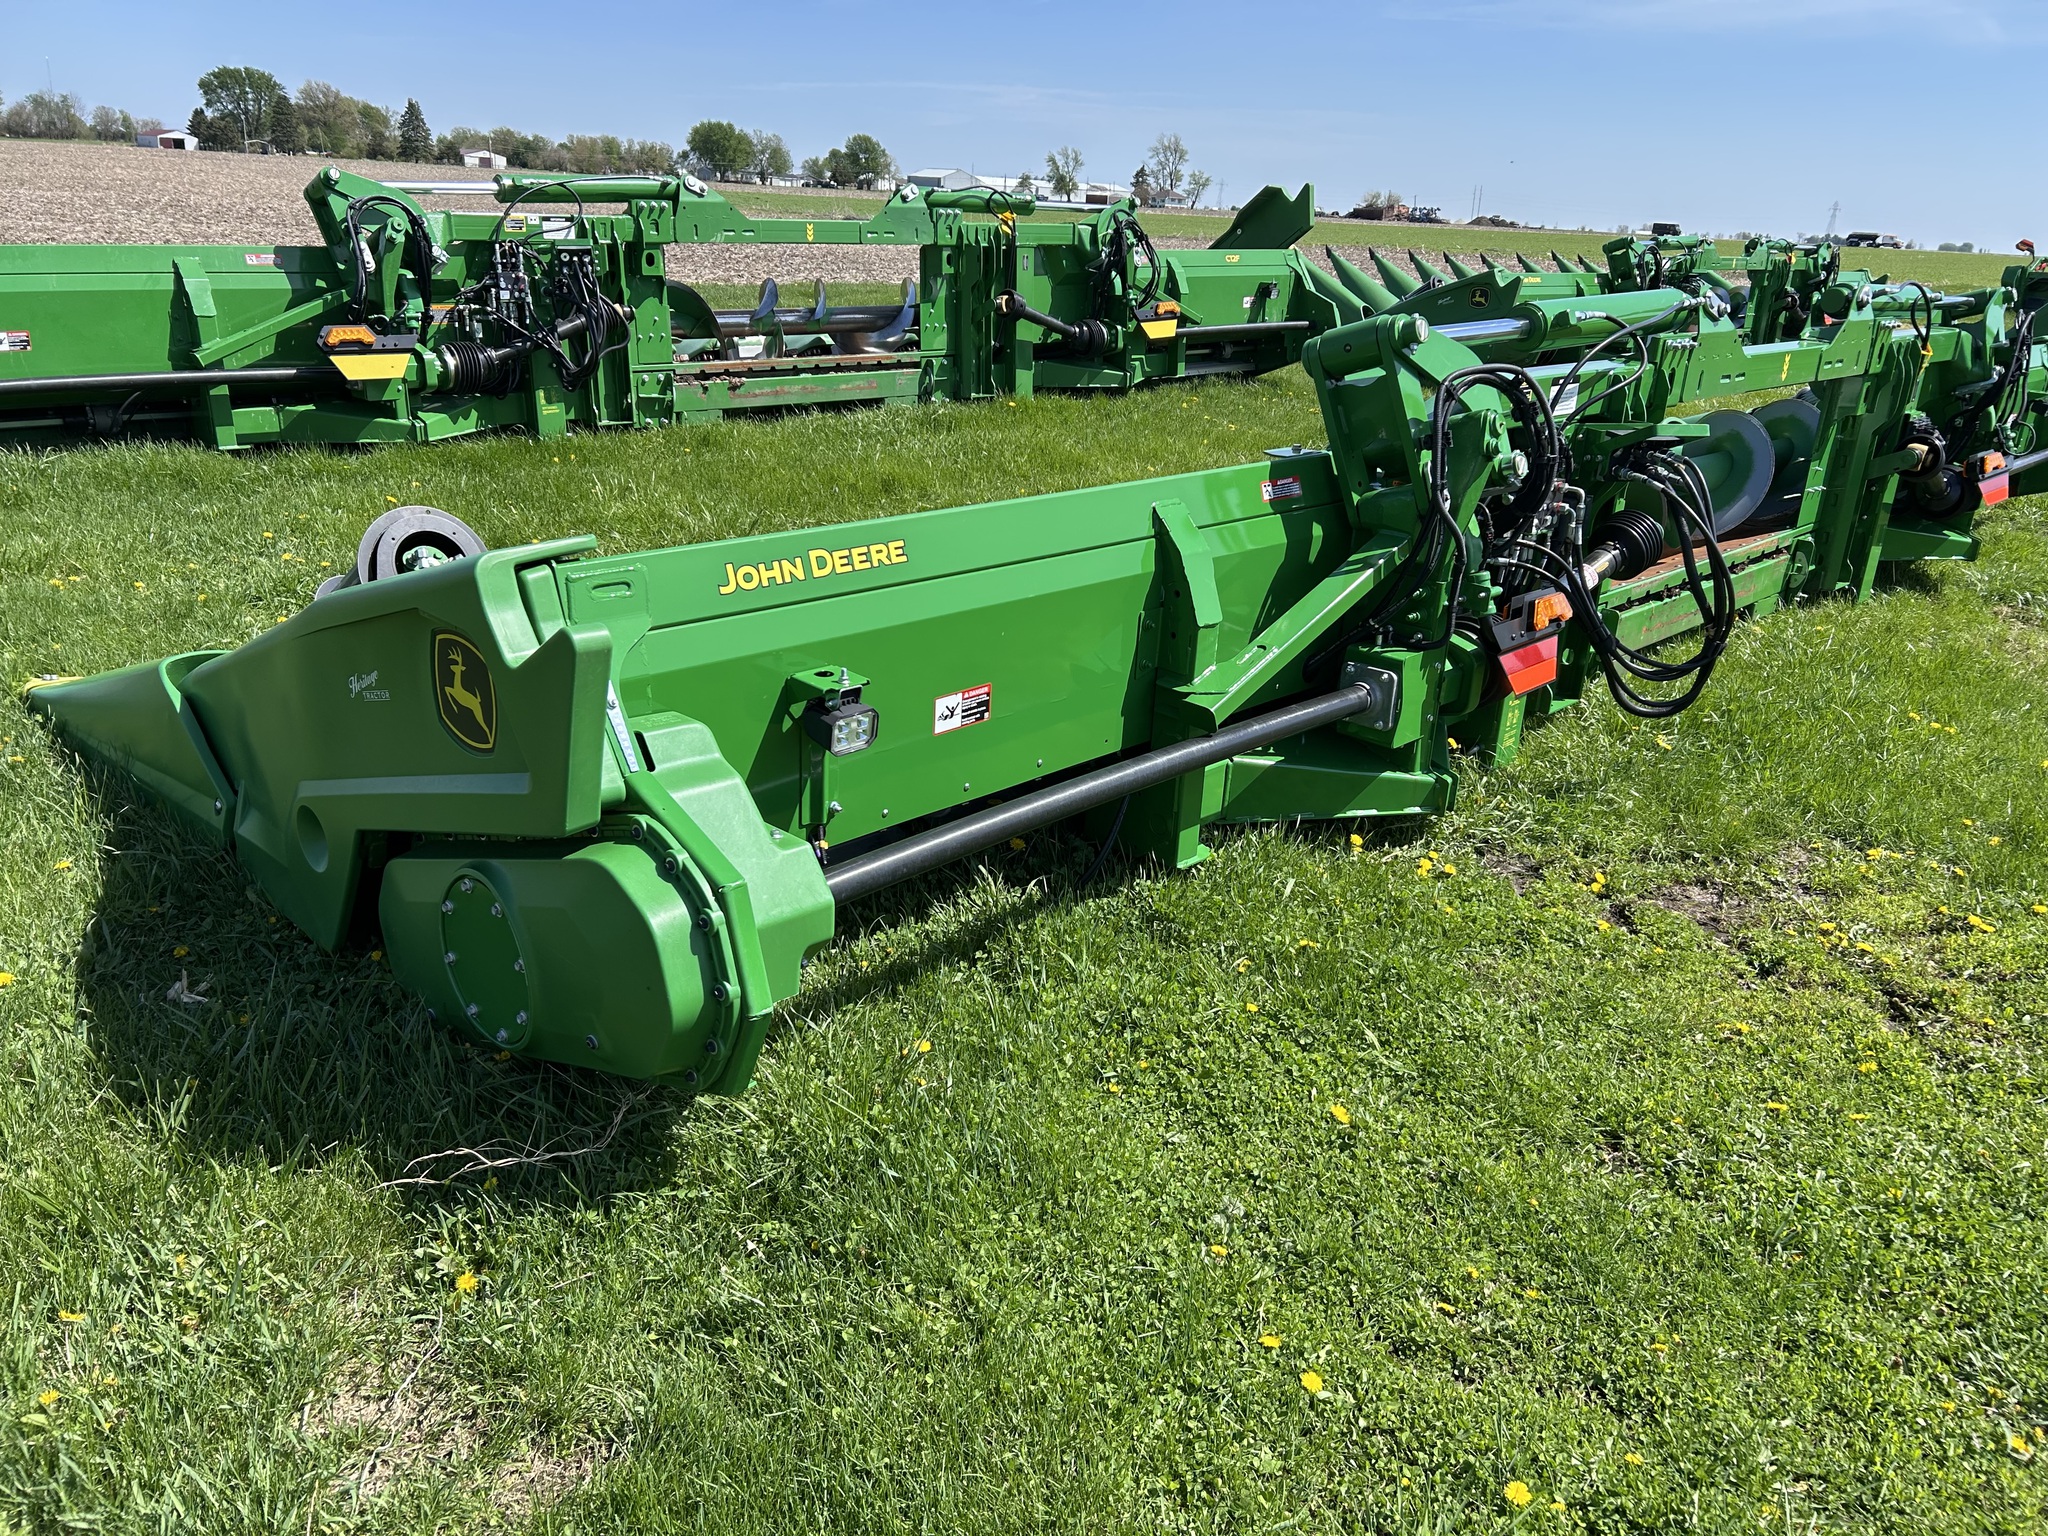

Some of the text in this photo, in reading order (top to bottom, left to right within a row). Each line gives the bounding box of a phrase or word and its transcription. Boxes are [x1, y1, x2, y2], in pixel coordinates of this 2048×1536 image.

[718, 539, 908, 595] JOHN DEERE
[348, 670, 378, 698] Heritage
[362, 691, 390, 699] TRACTOR
